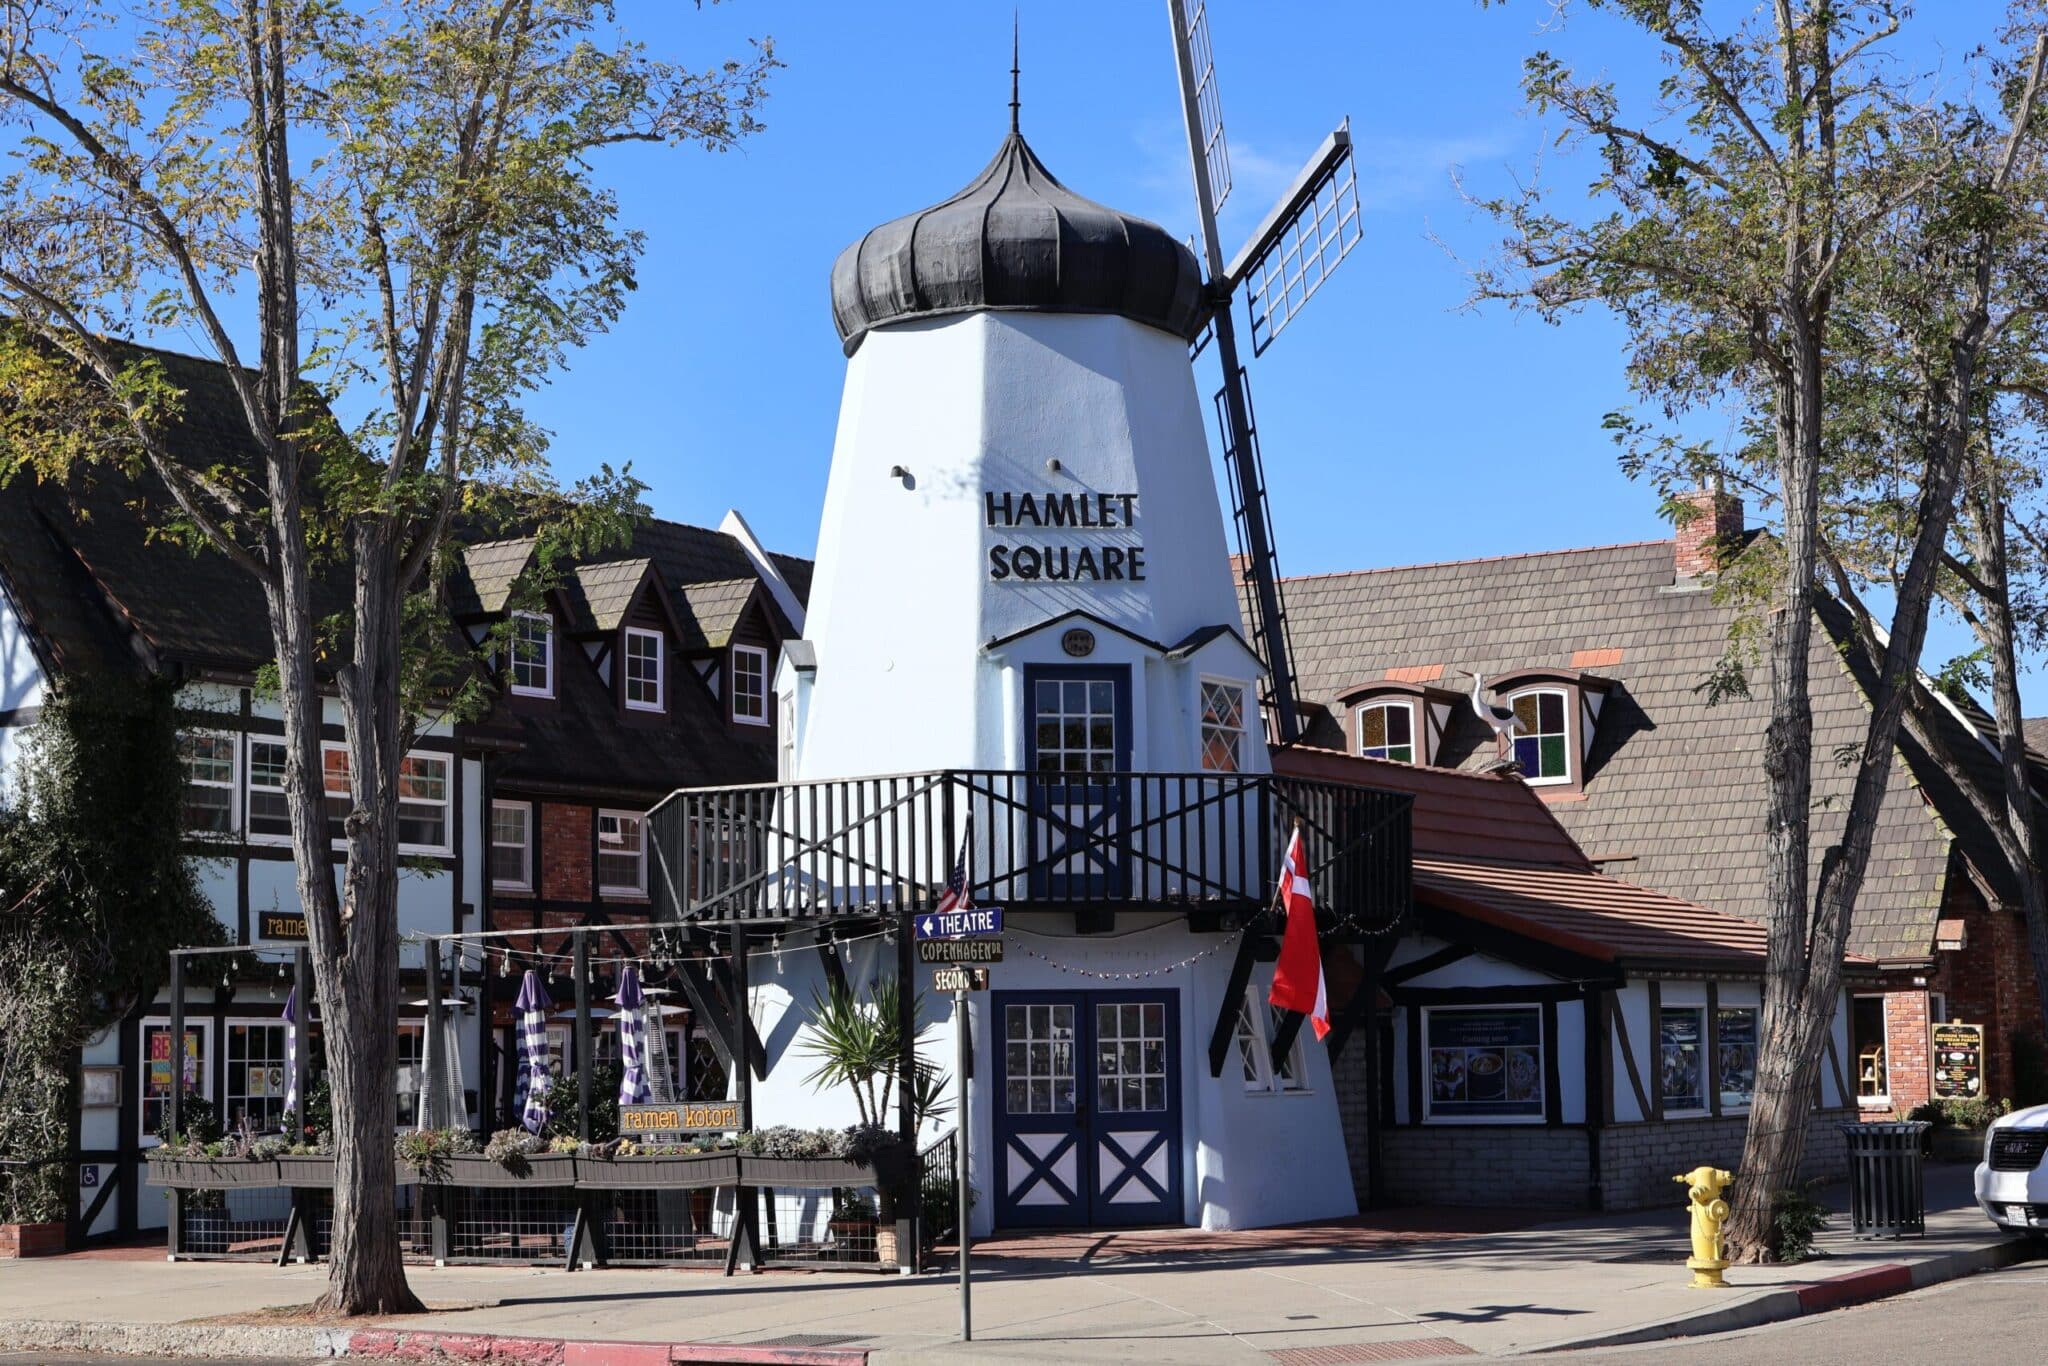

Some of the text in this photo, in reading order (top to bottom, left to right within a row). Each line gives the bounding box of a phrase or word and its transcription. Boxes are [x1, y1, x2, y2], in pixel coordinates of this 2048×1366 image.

[985, 492, 1138, 527] HAMLET
[989, 544, 1146, 581] SQUARE
[267, 918, 306, 936] rame
[938, 911, 994, 934] THEATRE
[921, 942, 992, 961] COPENHAGEN
[935, 970, 970, 990] SECOND
[624, 1104, 738, 1129] ramen kotori
